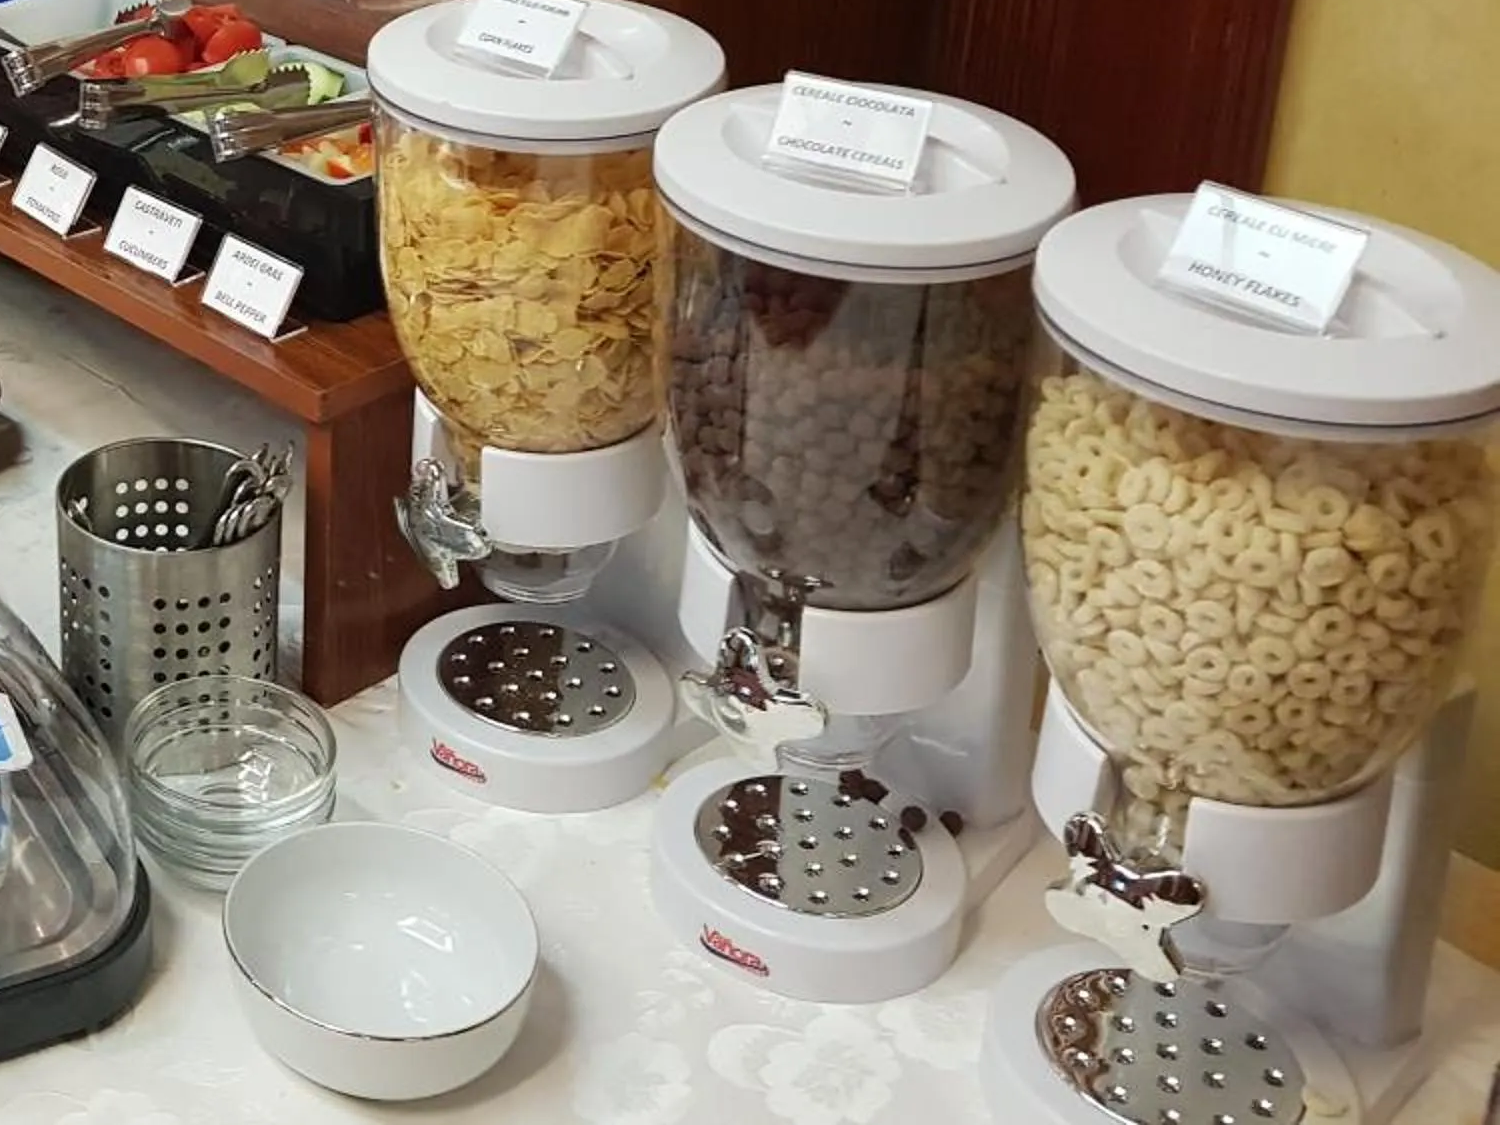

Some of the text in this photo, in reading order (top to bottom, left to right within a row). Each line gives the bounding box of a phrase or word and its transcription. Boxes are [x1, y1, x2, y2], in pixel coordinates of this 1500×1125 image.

[792, 85, 845, 105] CEREALE
[777, 134, 906, 171] CHOCOLATE CEREALS
[1187, 259, 1302, 309] HONEY FLAKES
